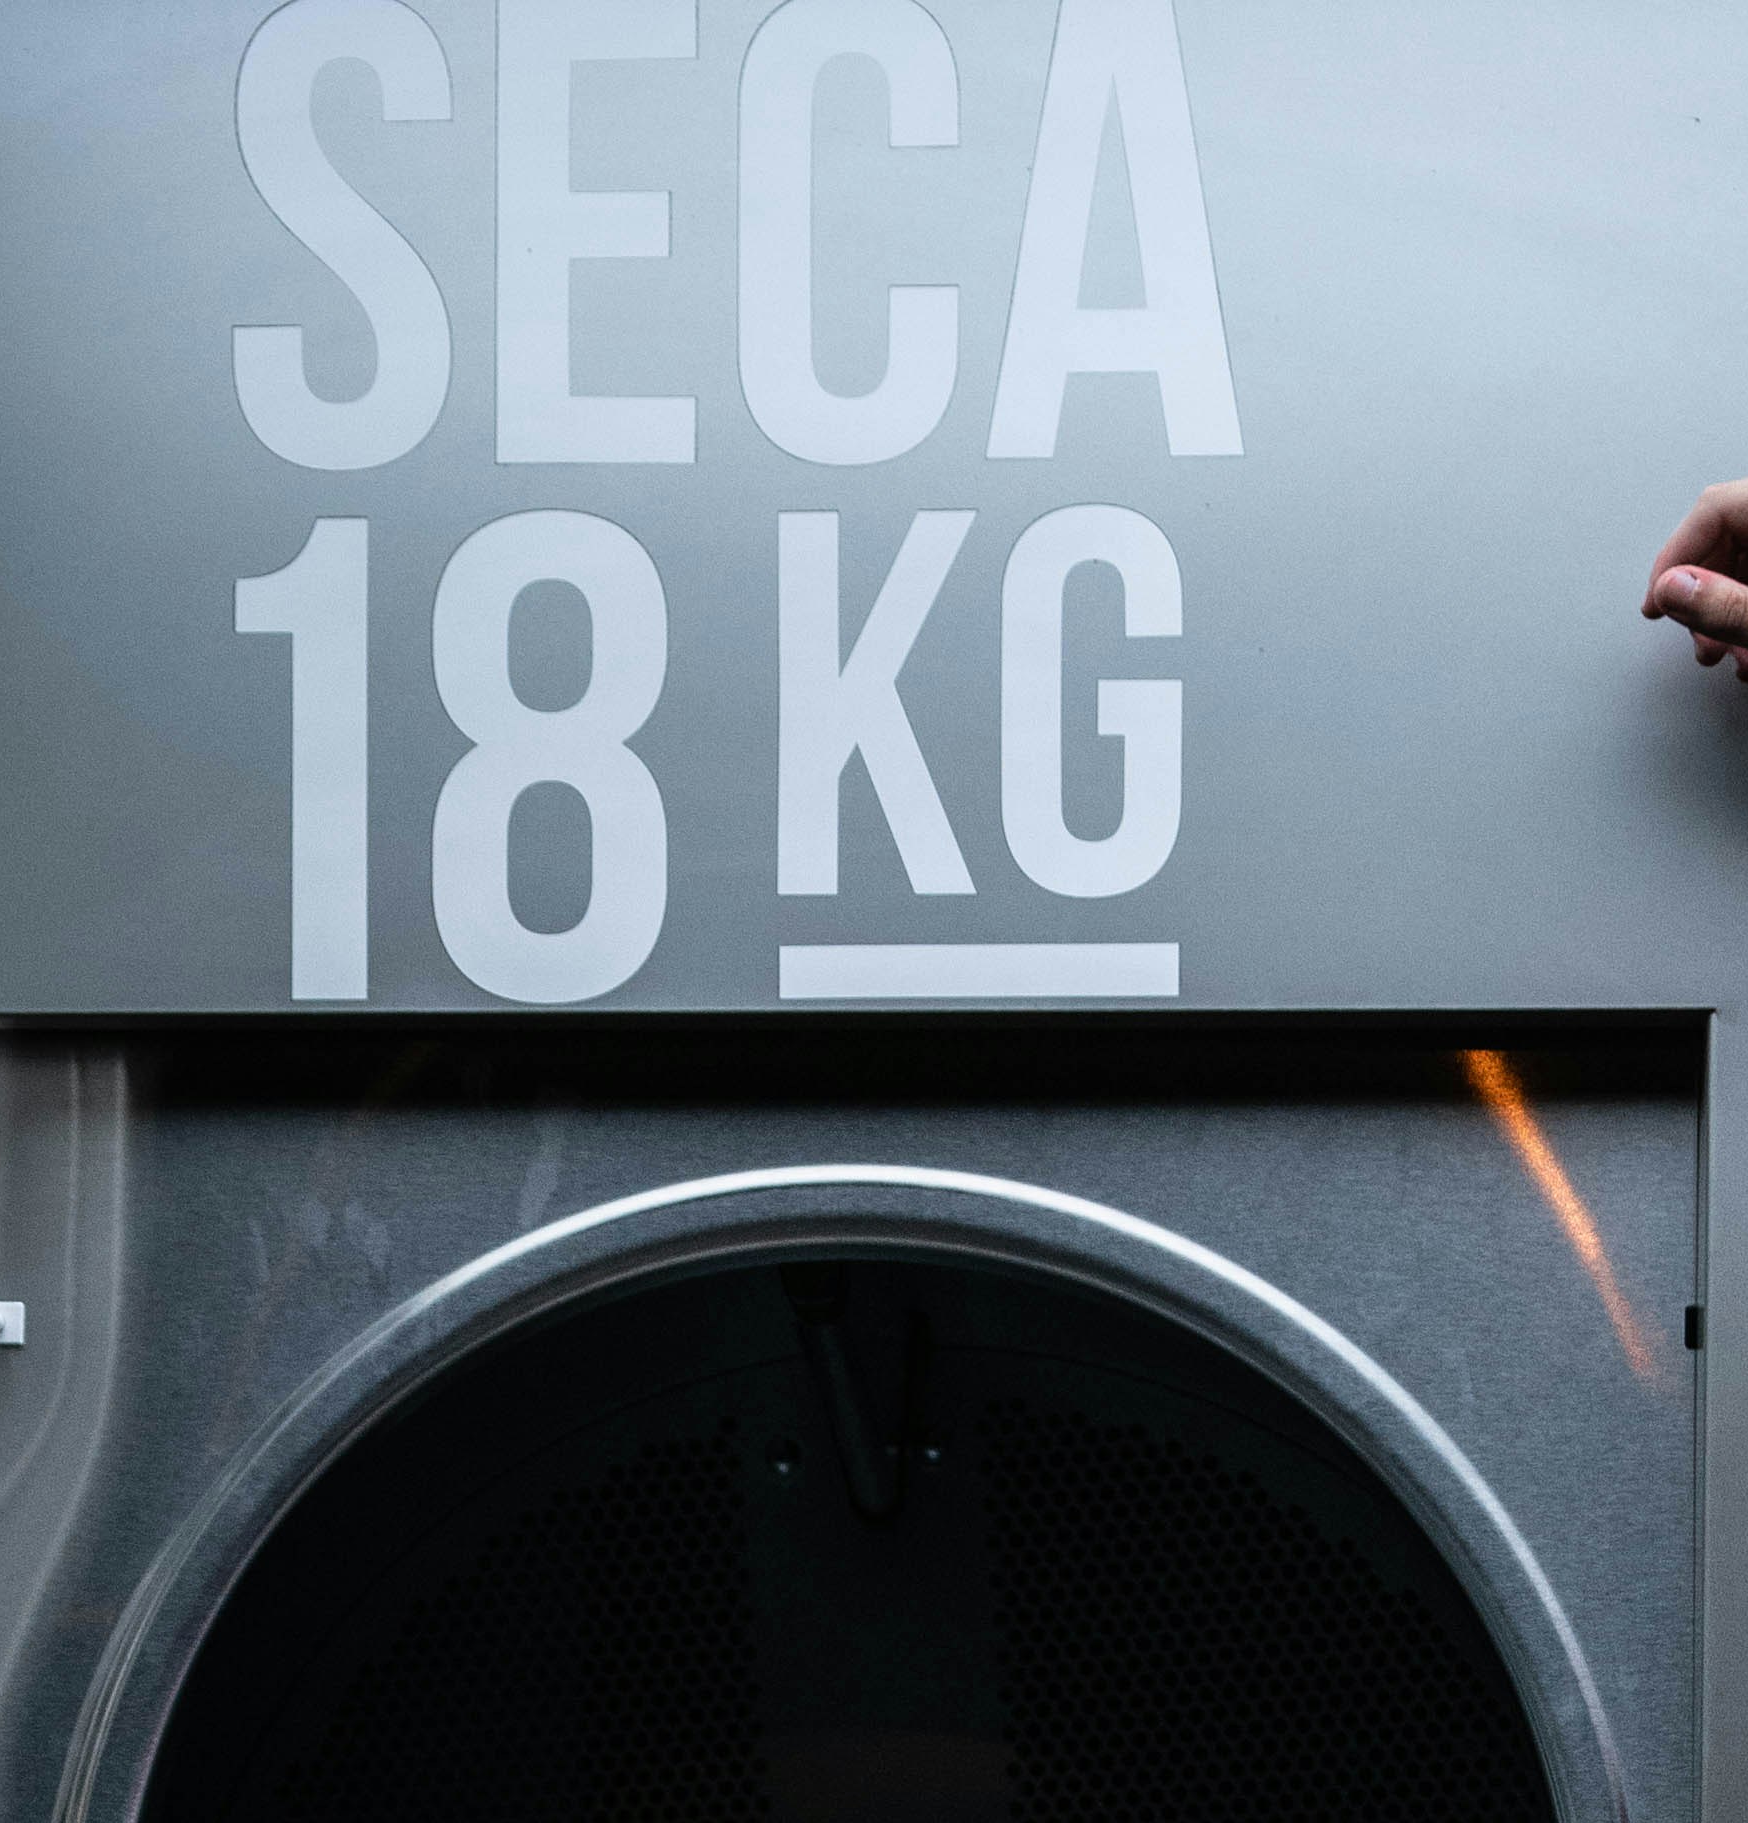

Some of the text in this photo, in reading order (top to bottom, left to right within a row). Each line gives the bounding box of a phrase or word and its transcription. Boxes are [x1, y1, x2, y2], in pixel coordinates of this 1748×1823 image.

[232, 0, 1245, 470] SECA
[234, 502, 1184, 1003] 18 KG
